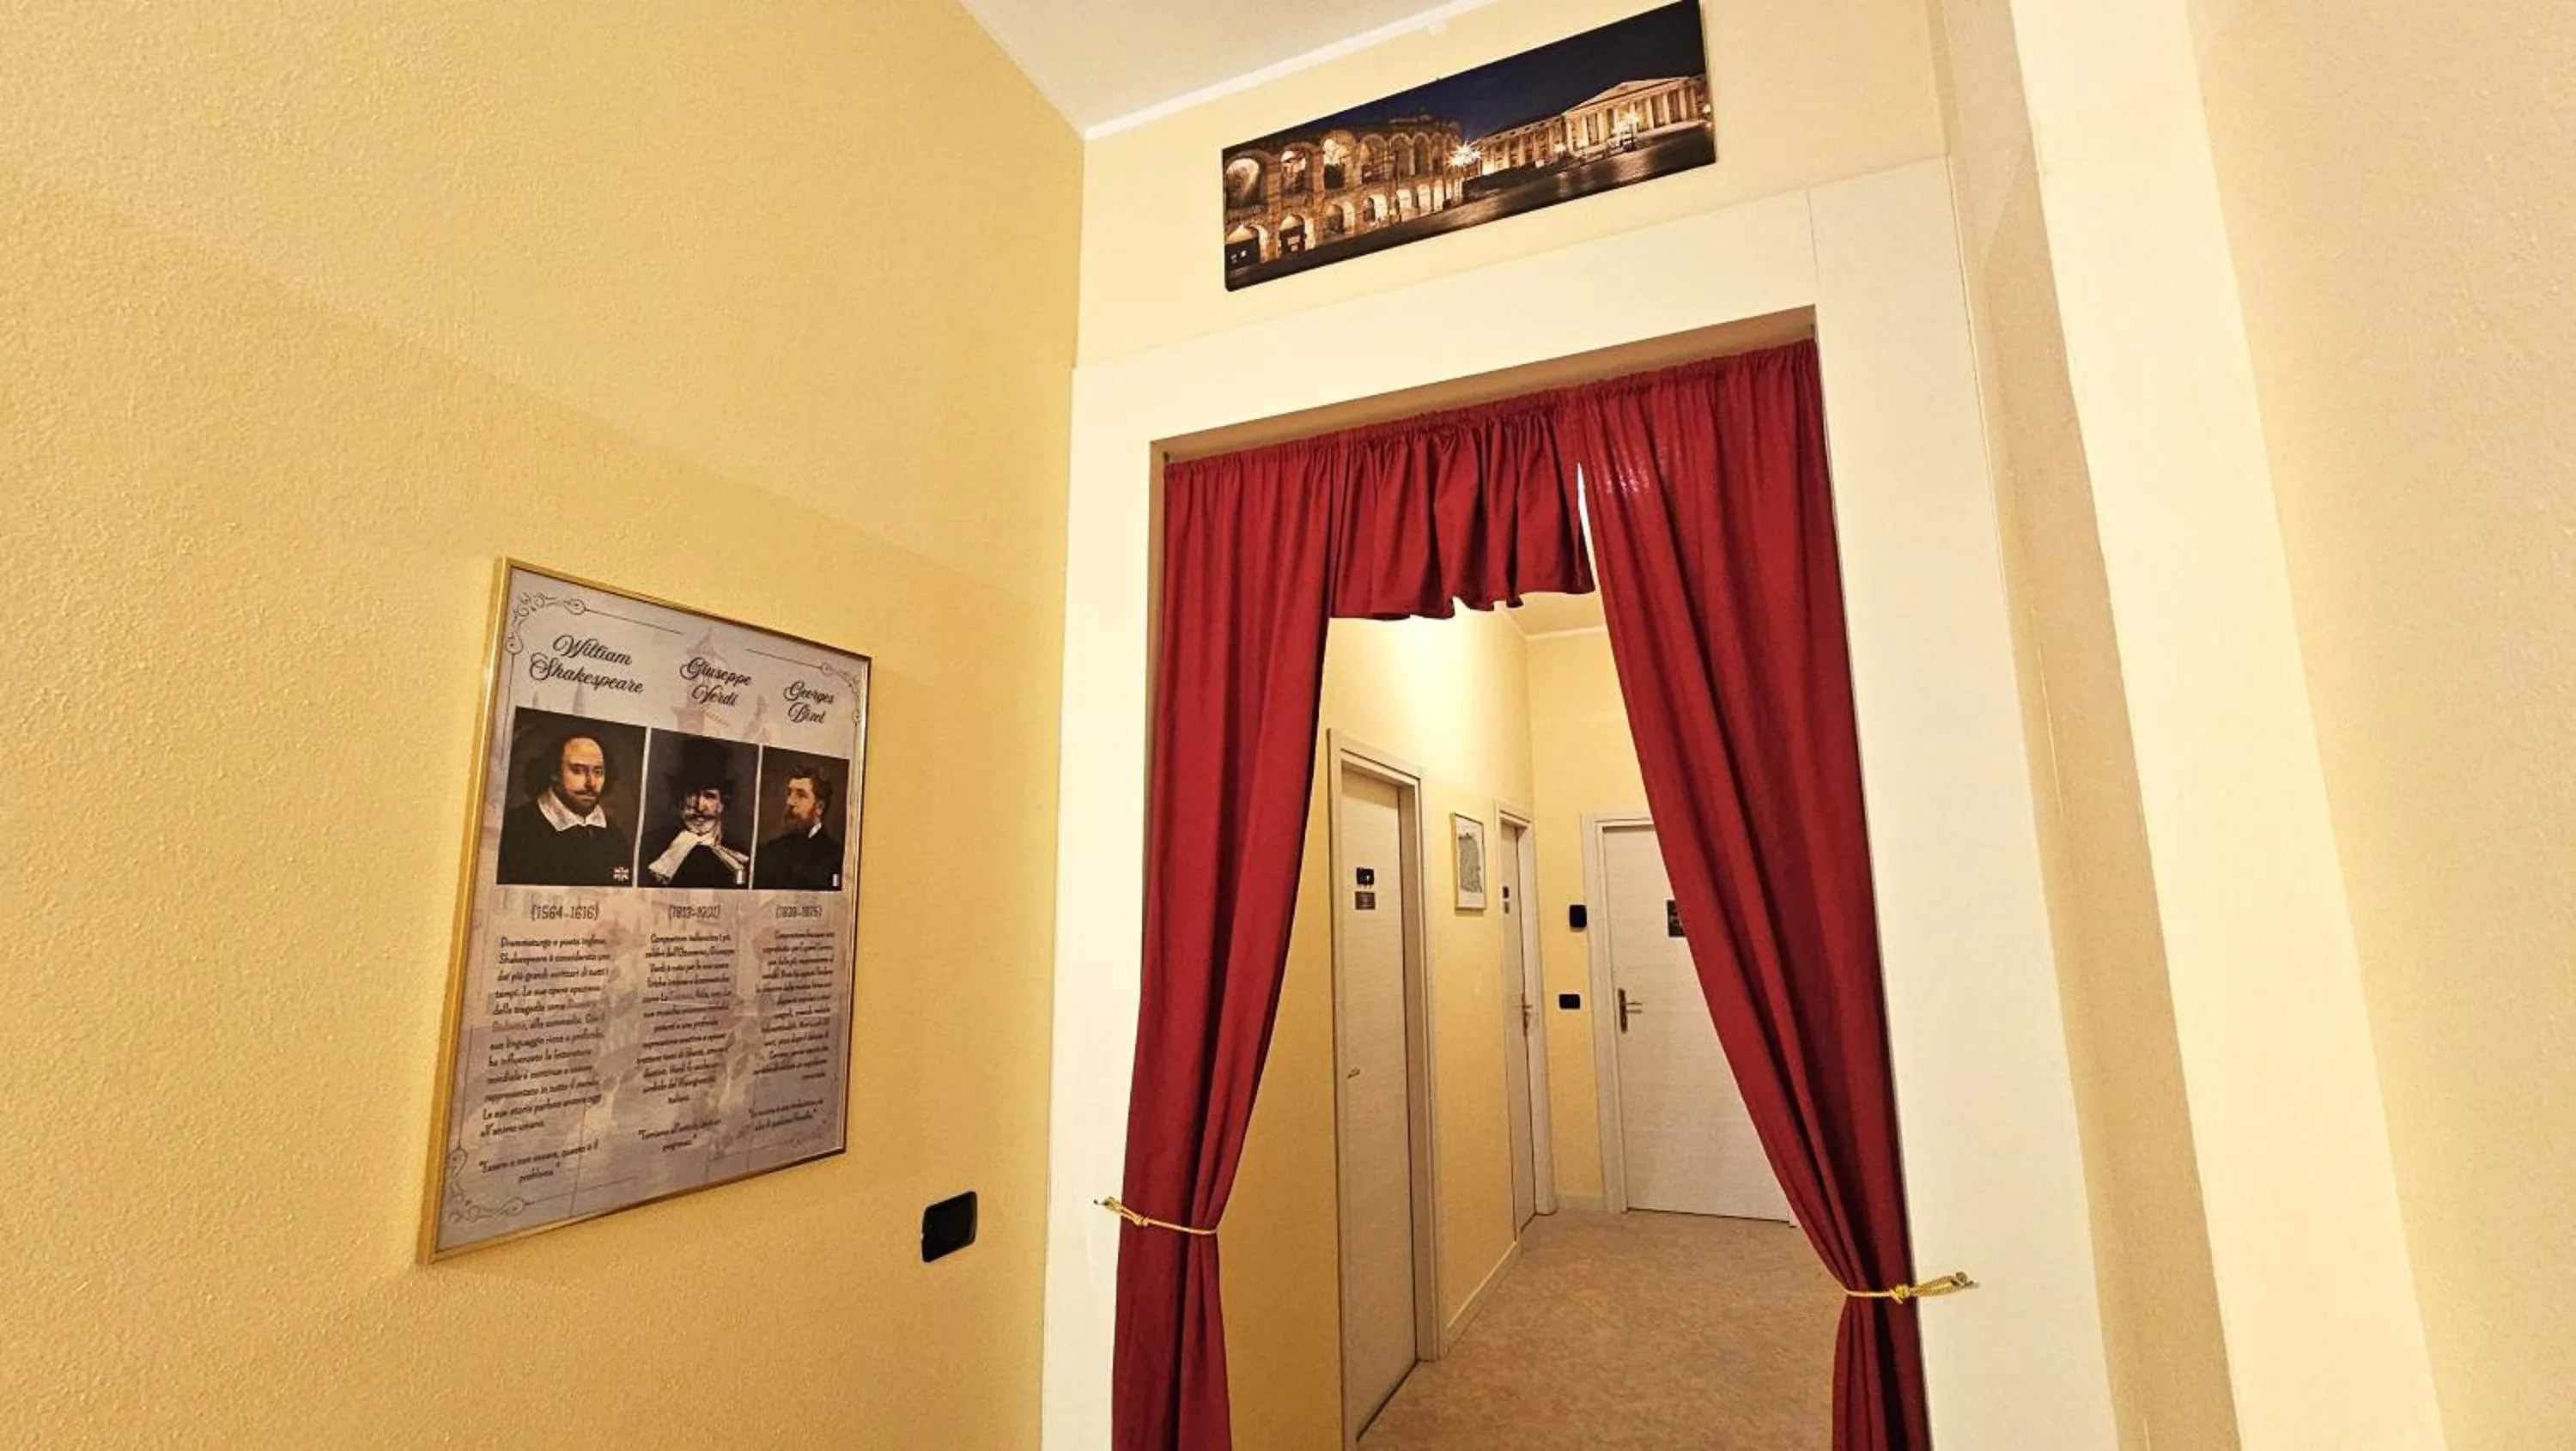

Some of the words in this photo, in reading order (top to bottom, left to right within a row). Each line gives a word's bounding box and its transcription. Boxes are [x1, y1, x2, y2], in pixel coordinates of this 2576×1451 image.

[552, 634, 631, 665] William
[529, 652, 643, 693] Shakespeare
[679, 657, 750, 686] Giuseppe
[691, 678, 738, 706] Verdi
[783, 681, 834, 705] Georges
[498, 951, 547, 965] Shakespeare
[555, 950, 596, 962] considerato
[525, 968, 548, 981] grandi
